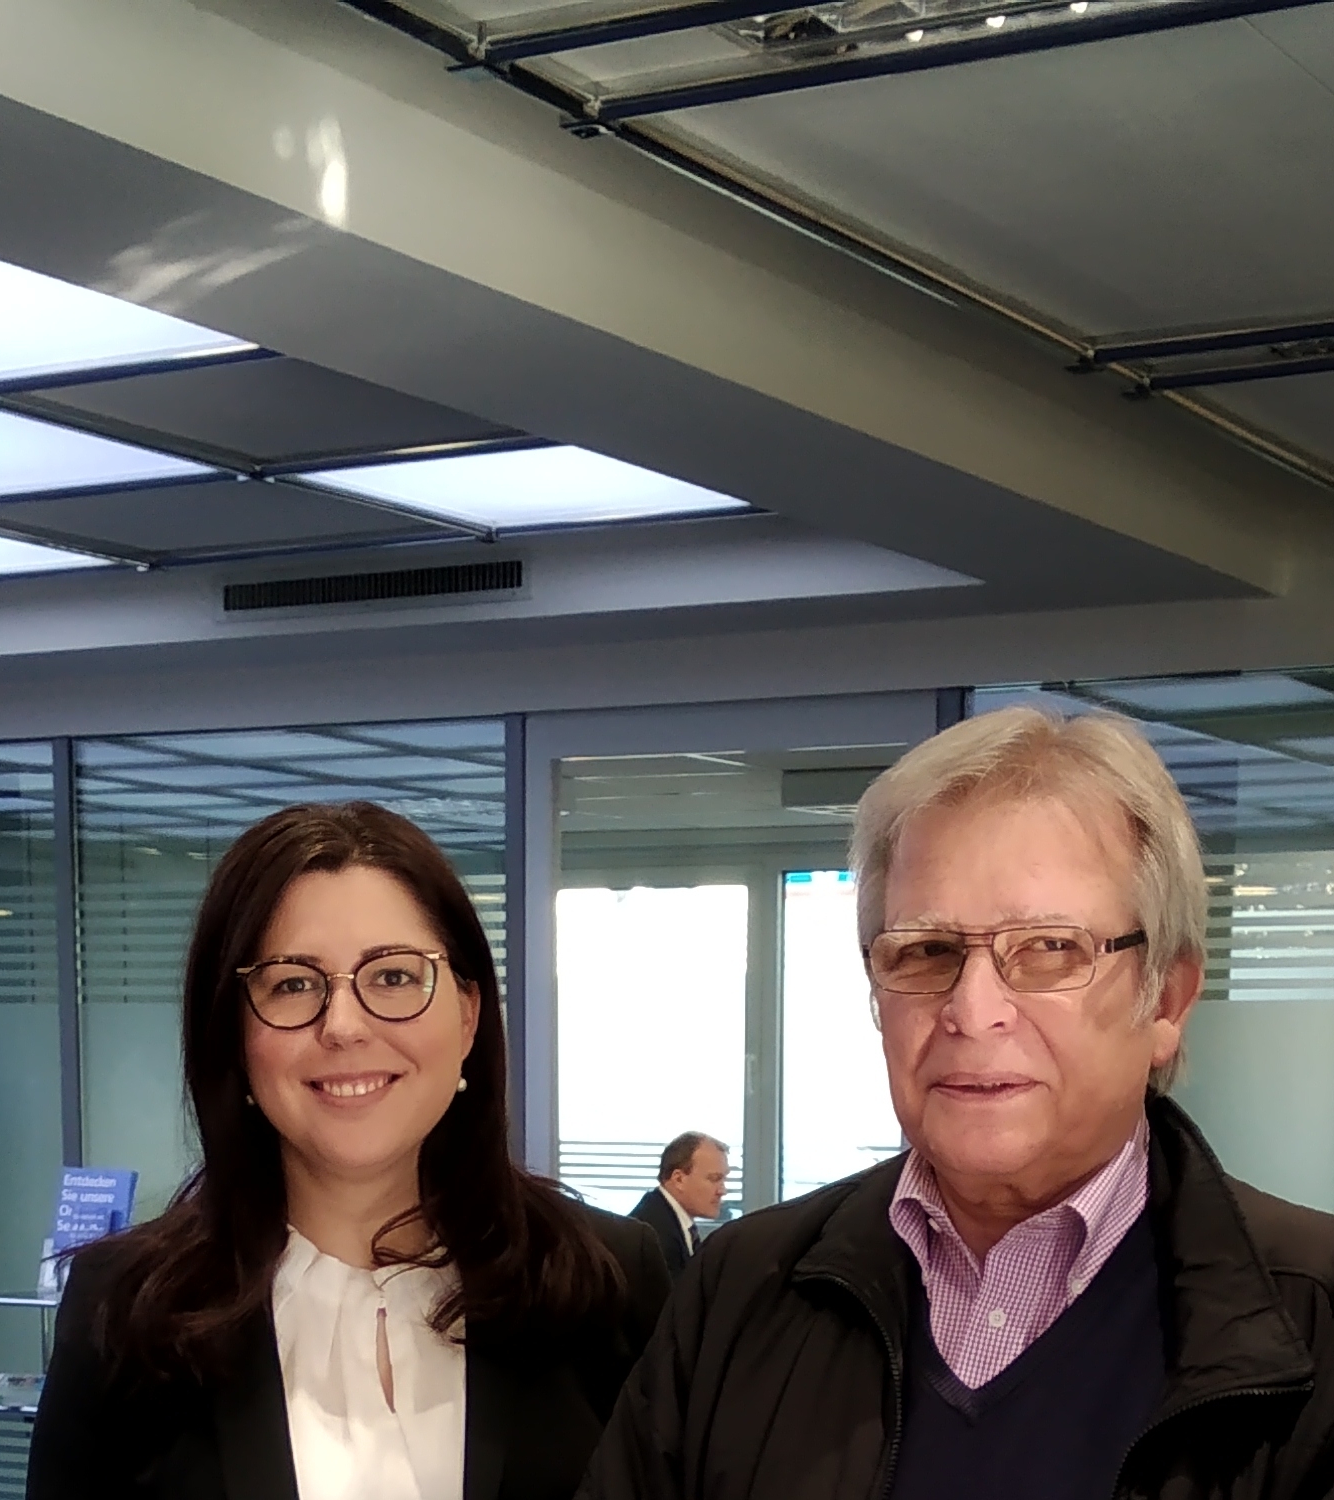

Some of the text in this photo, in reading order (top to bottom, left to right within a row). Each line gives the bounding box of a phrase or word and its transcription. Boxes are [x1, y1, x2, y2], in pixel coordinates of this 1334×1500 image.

[63, 1173, 117, 1188] Entdecken
[61, 1188, 115, 1203] Sie unsere
